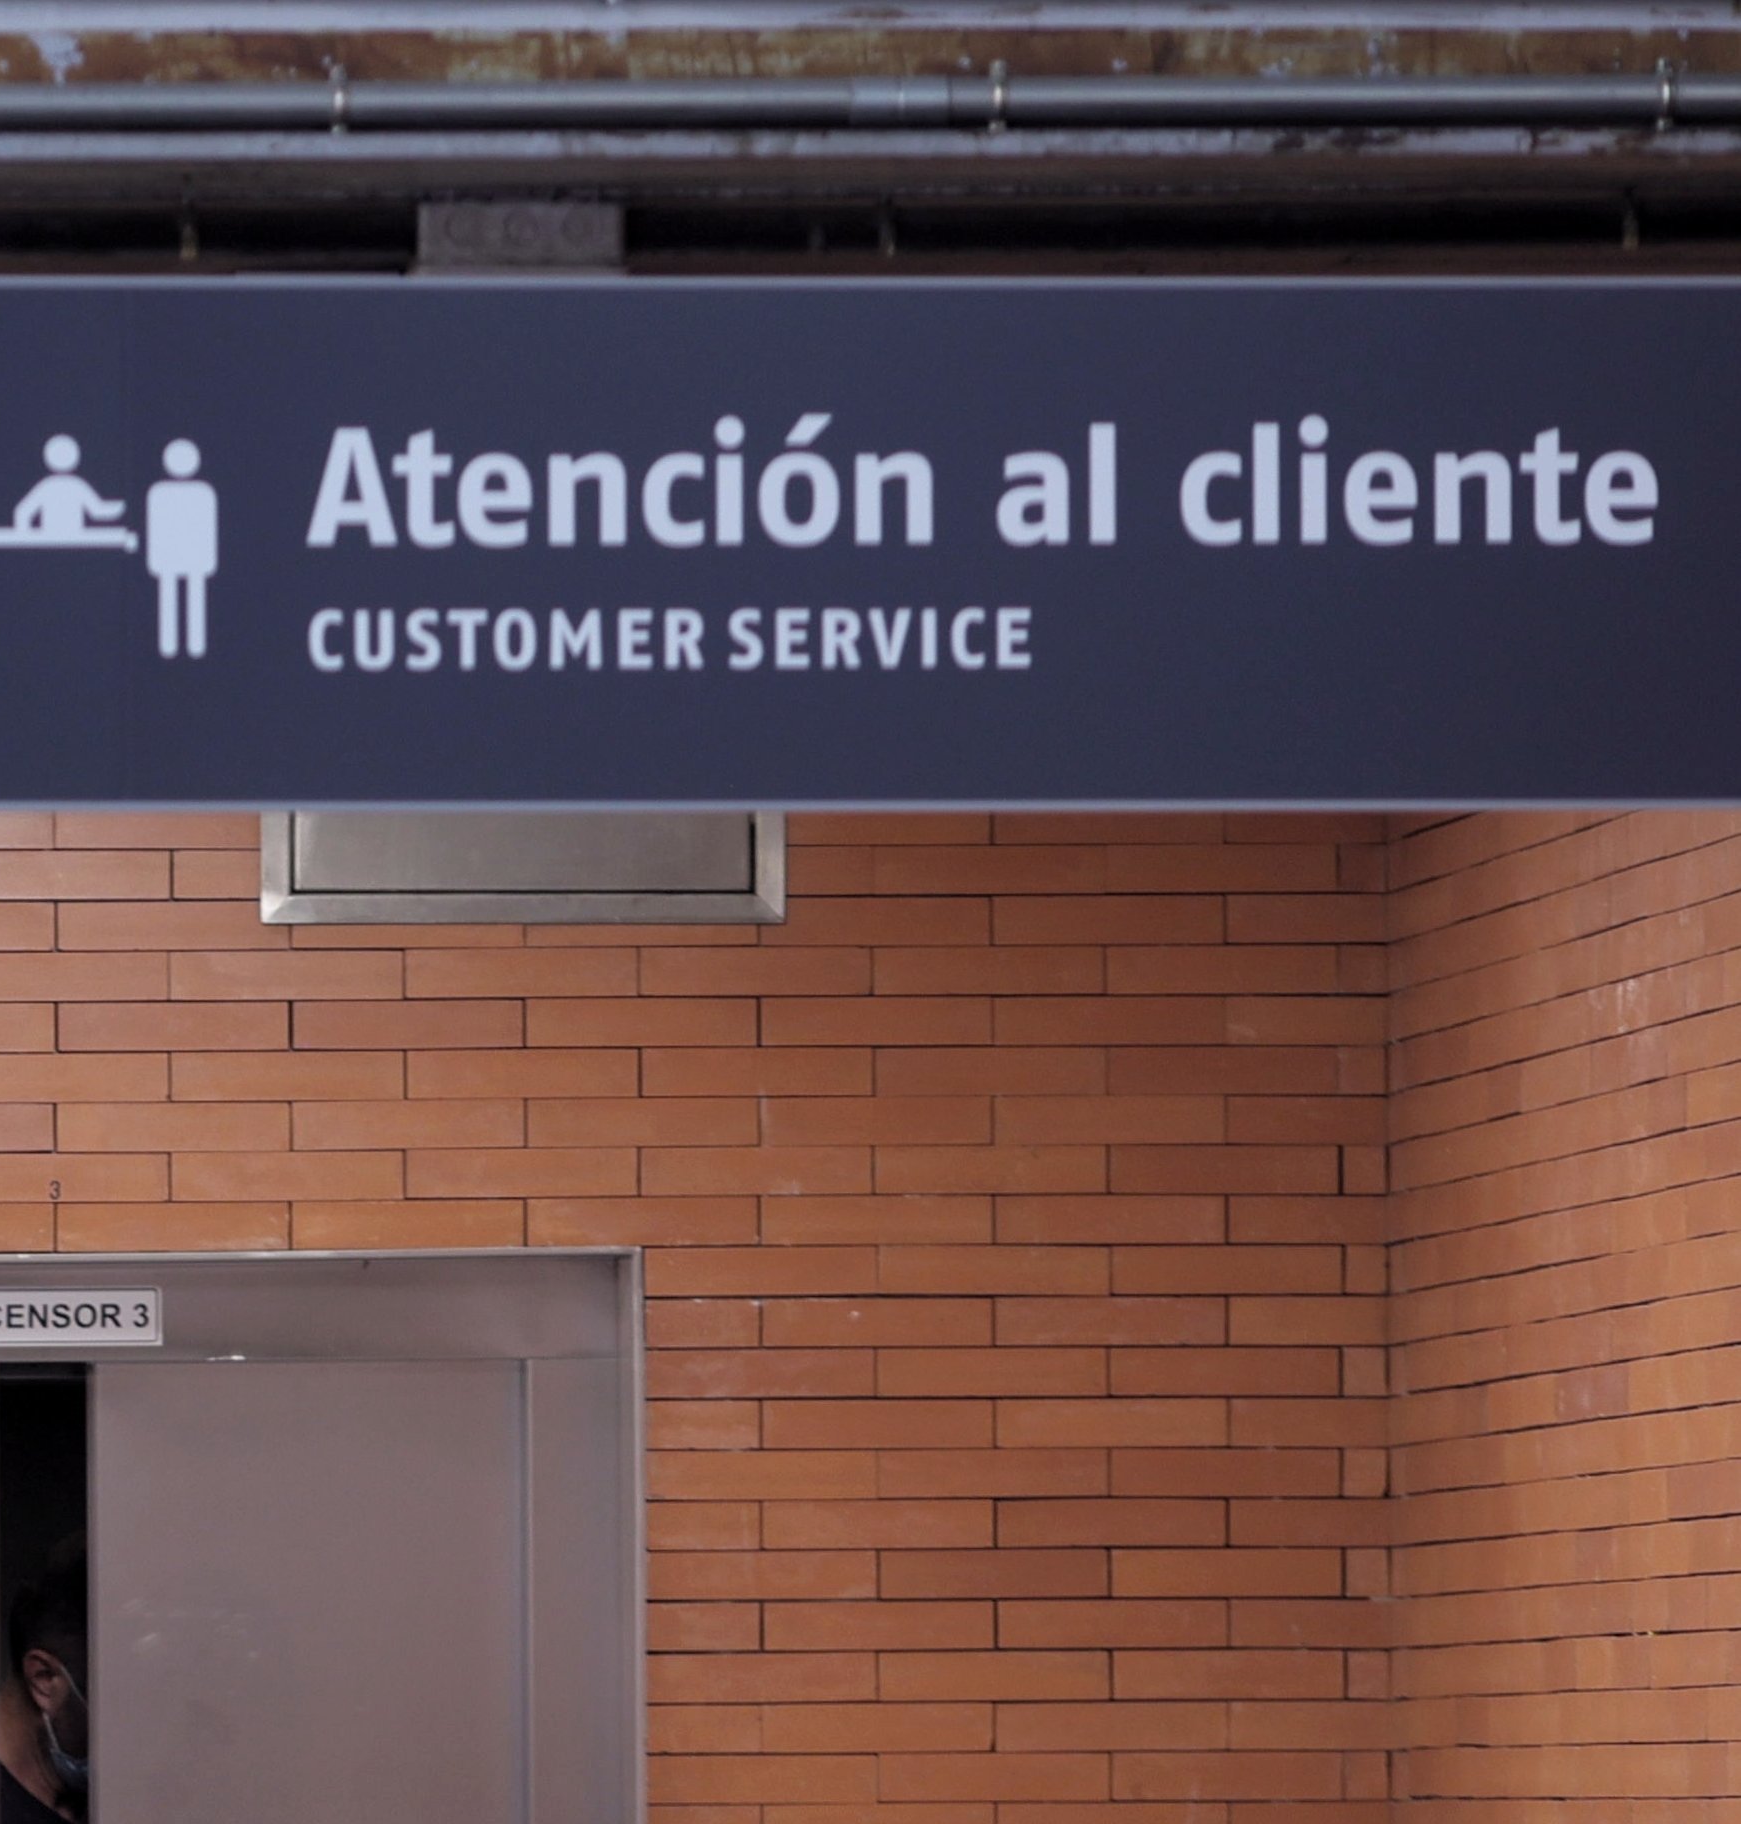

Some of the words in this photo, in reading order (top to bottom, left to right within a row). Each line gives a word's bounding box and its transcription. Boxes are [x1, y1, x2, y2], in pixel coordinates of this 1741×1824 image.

[306, 413, 933, 548] Atención
[996, 422, 1116, 546] al
[1180, 414, 1658, 545] cliente
[308, 608, 704, 672] CUSTOMER
[728, 606, 1032, 670] SERVICE
[132, 1303, 150, 1329] 3
